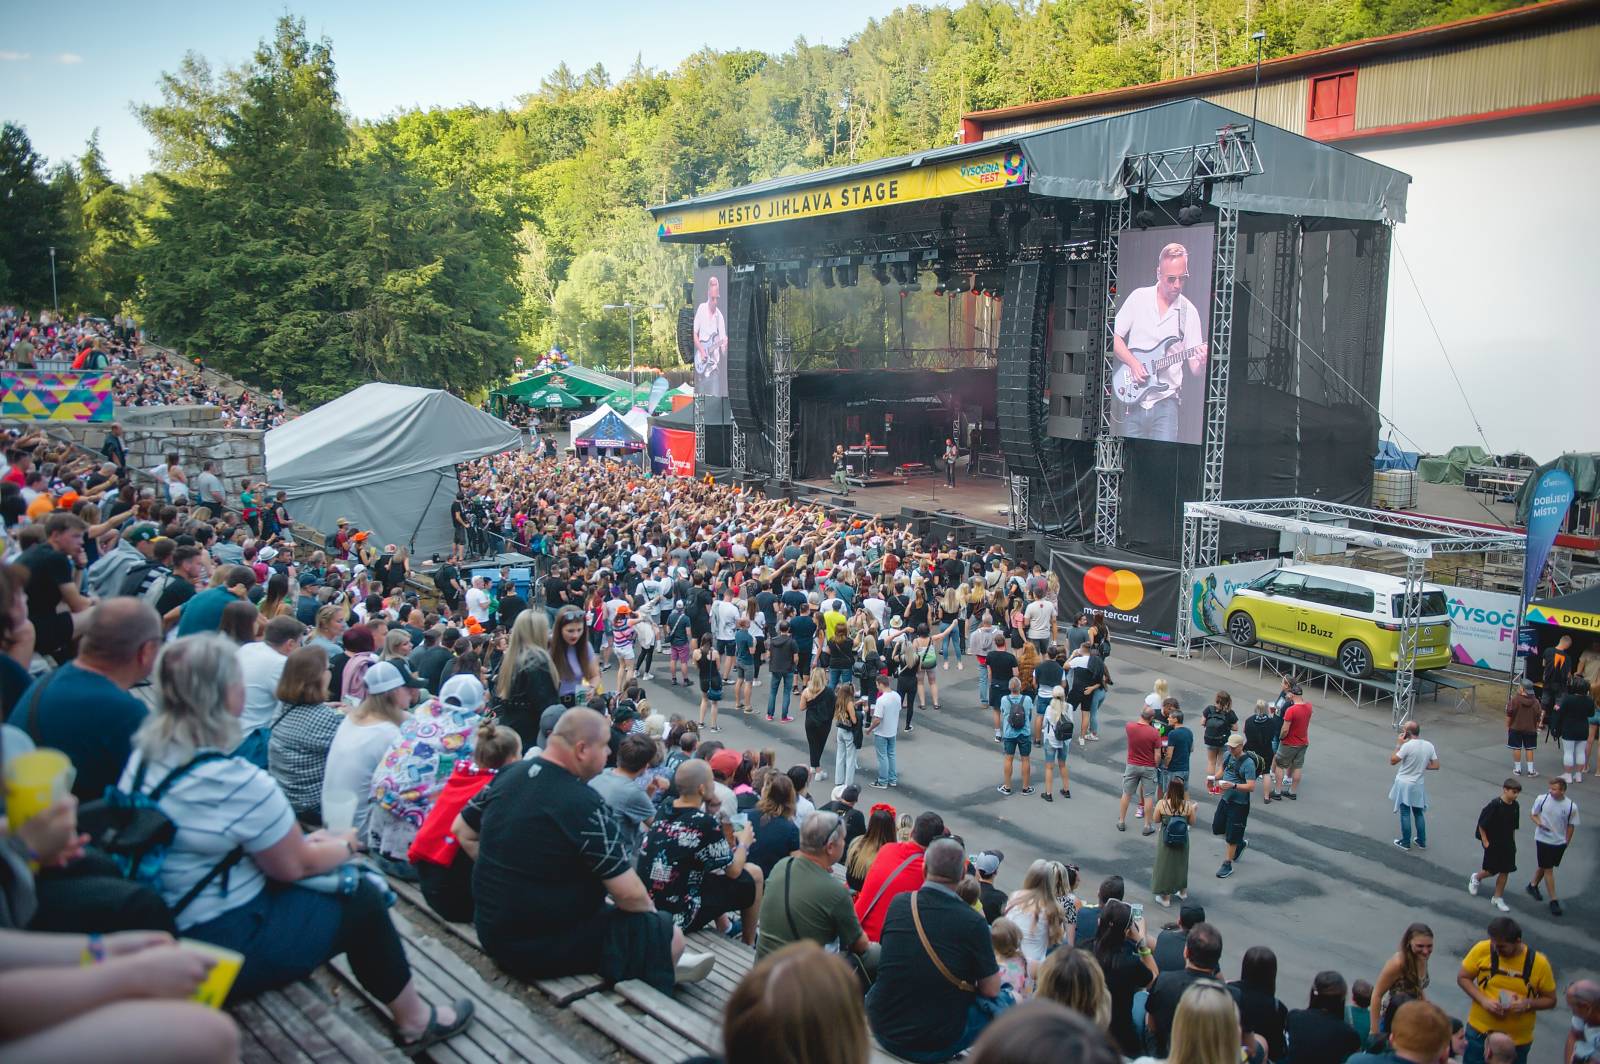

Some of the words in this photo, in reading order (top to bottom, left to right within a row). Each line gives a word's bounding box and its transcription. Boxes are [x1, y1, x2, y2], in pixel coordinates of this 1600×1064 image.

[980, 172, 1000, 184] FEST
[718, 204, 761, 225] MĚSTO
[768, 192, 832, 218] JIHLAVA
[841, 180, 899, 206] STAGE
[1534, 491, 1569, 506] DOBÍJECÍ
[1534, 506, 1558, 518] MÍSTO
[1297, 620, 1334, 639] ID.Buzz
